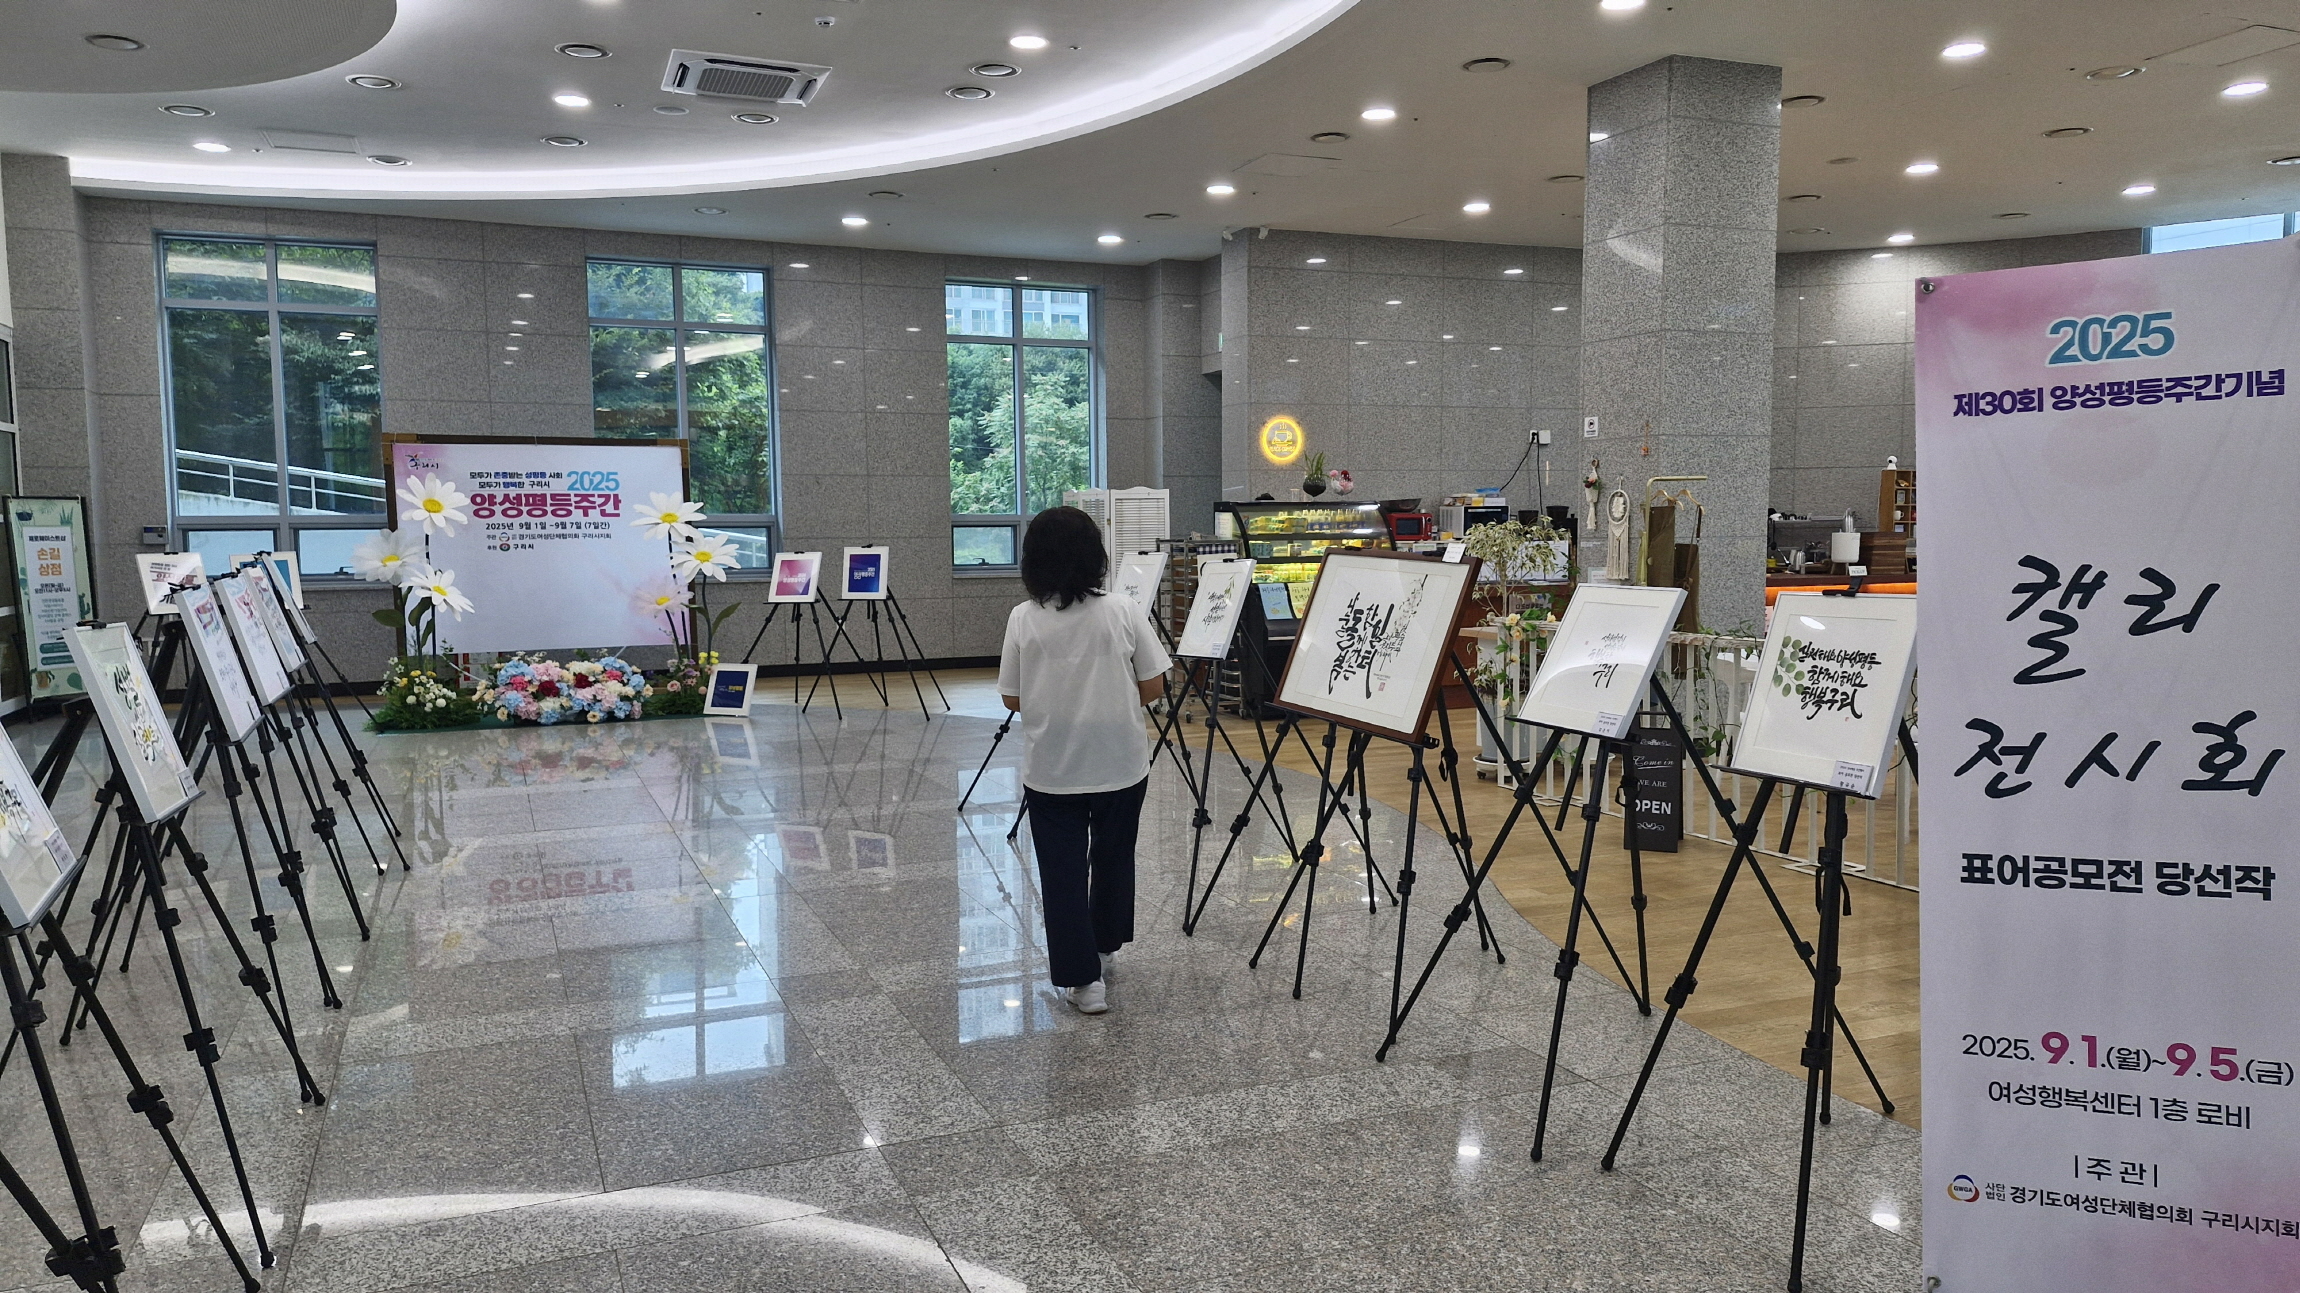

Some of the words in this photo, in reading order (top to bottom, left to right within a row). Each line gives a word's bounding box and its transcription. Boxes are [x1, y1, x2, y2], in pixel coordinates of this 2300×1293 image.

[2048, 311, 2175, 365] 2025
[1953, 388, 2044, 417] 제30회
[2050, 369, 2285, 411] 양성평등주간기념
[528, 480, 550, 488] 구리시
[567, 471, 620, 492] 2025
[470, 493, 621, 519] 양성평등주간
[486, 522, 514, 530] 2025년
[534, 522, 546, 530] 1일
[570, 522, 582, 530] 7일
[584, 522, 610, 530] (7일간)
[39, 563, 62, 576] 상점
[1633, 756, 1662, 766] Come
[1954, 710, 2286, 799] 전시회
[1960, 853, 2143, 893] 표어공모전
[2155, 861, 2276, 901] 당선작
[1988, 1081, 2142, 1118] 여성행복센터
[2150, 1098, 2188, 1122] 1층
[2196, 1102, 2251, 1130] 로비
[1985, 1183, 2005, 1192] 사단
[1985, 1191, 2006, 1201] 법인
[2010, 1186, 2193, 1226] 경기도여성단체협의회
[2200, 1210, 2300, 1240] 구리시지회
